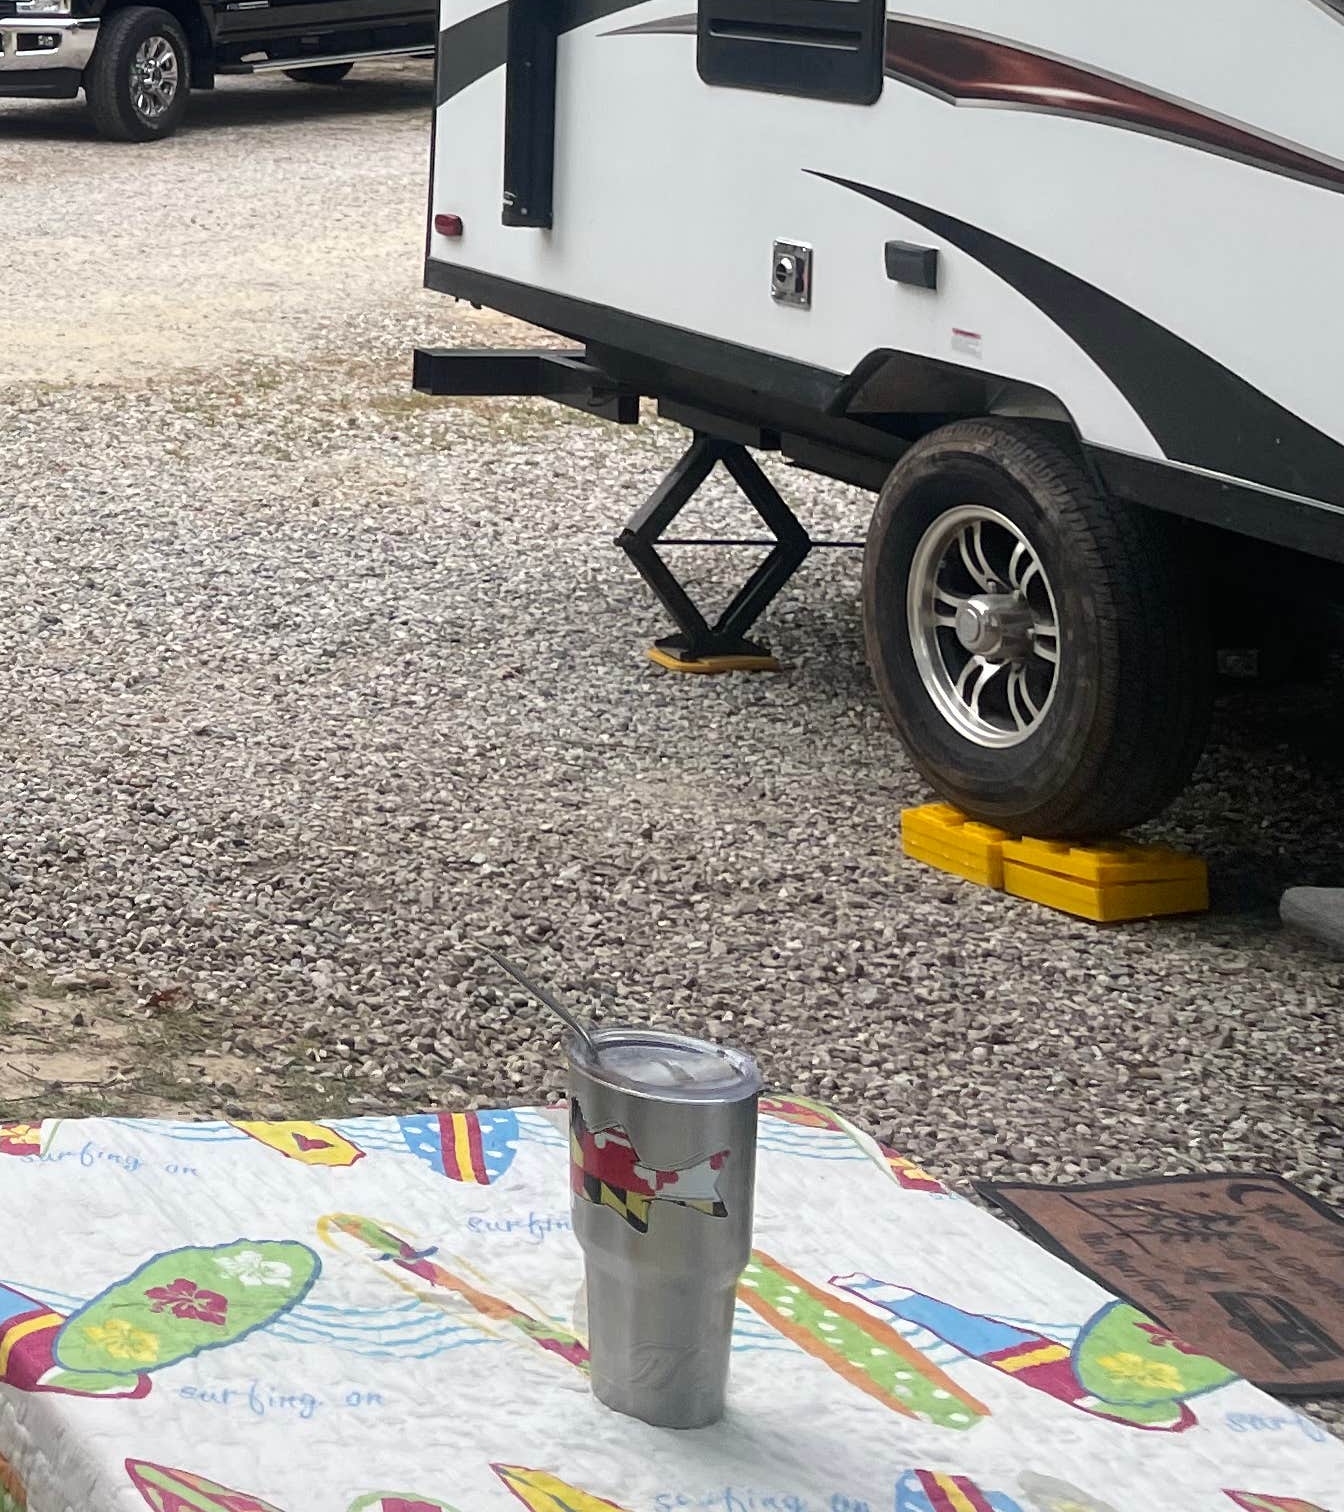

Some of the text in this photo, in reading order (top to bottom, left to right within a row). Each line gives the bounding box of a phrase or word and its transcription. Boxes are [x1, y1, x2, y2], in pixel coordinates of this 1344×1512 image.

[164, 1163, 199, 1176] on
[466, 1211, 574, 1241] surfin
[344, 1390, 384, 1407] on
